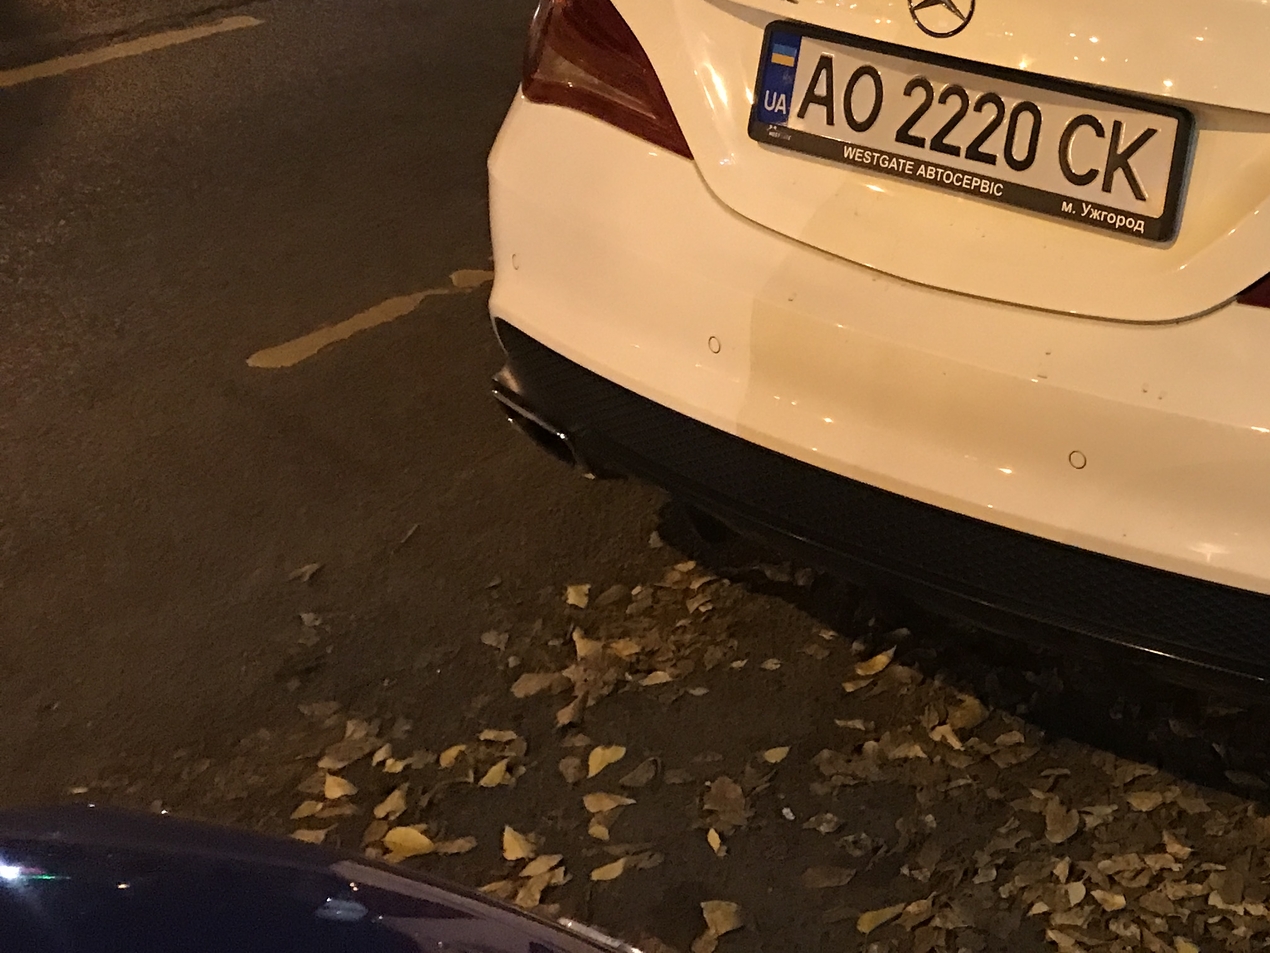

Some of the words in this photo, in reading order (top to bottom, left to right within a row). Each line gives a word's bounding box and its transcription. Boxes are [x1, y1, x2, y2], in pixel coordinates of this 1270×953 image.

[763, 89, 788, 115] UA
[797, 51, 884, 133] AO
[894, 73, 1043, 172] 2220
[1058, 113, 1159, 202] CK
[843, 145, 915, 175] WESTGATE
[916, 164, 1005, 197] АВТОСЕРВІС
[1061, 201, 1076, 214] м.
[1081, 202, 1145, 234] Ужгород
